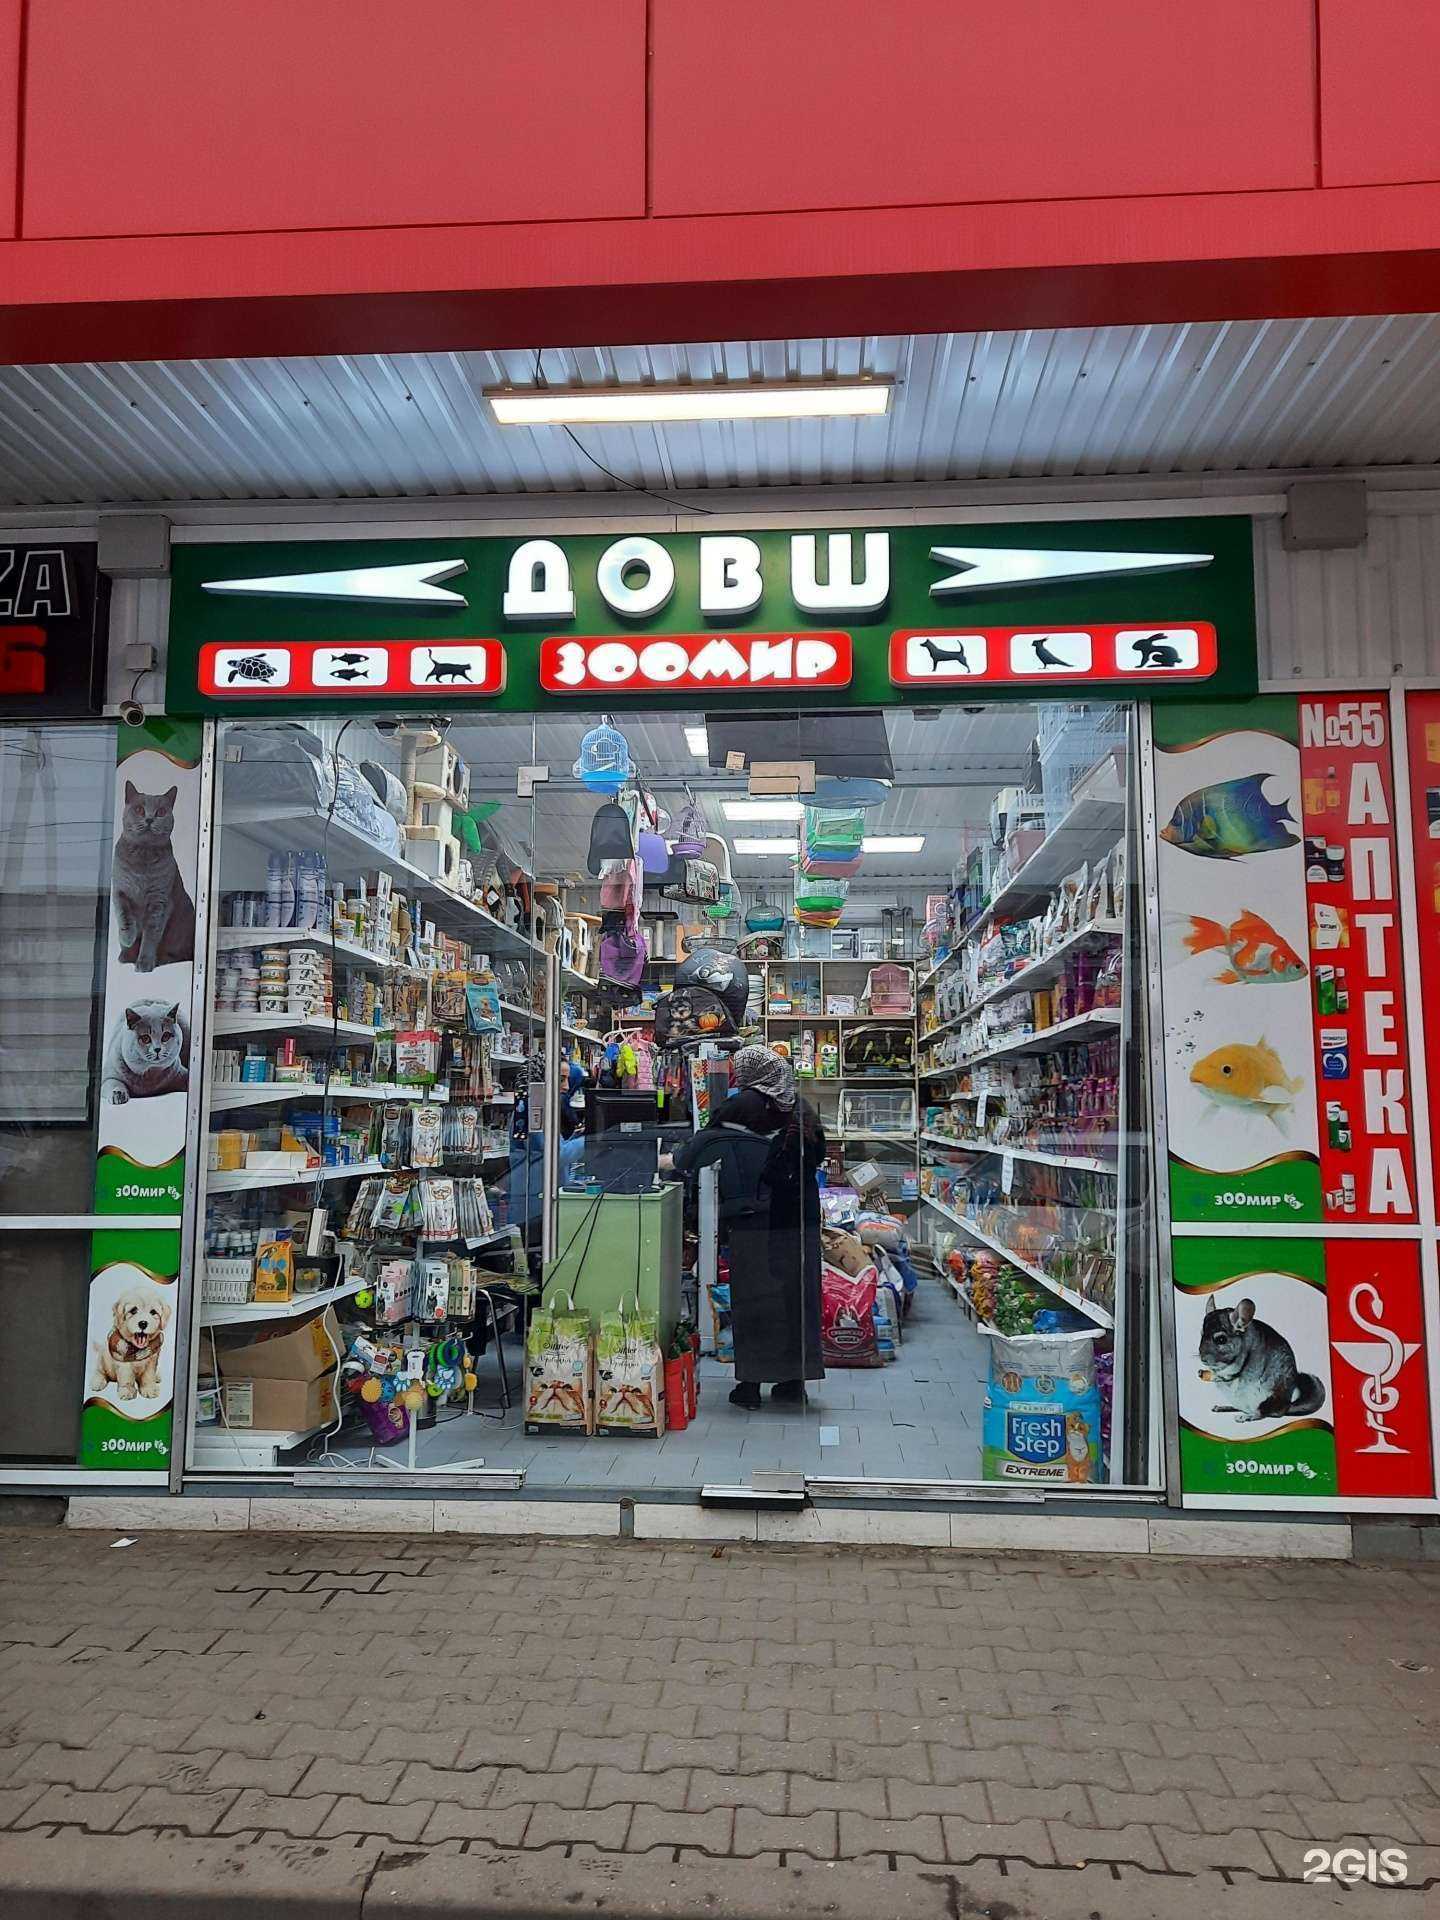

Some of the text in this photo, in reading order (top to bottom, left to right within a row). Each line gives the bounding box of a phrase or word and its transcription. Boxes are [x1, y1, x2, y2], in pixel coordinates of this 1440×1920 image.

[503, 533, 891, 618] ДОВШ
[553, 637, 838, 685] ЗООМИР
[1347, 762, 1413, 1214] АПТЕКА
[1012, 1417, 1062, 1437] Fresh
[1014, 1435, 1060, 1458] Step
[1005, 1464, 1065, 1477] EXTREME
